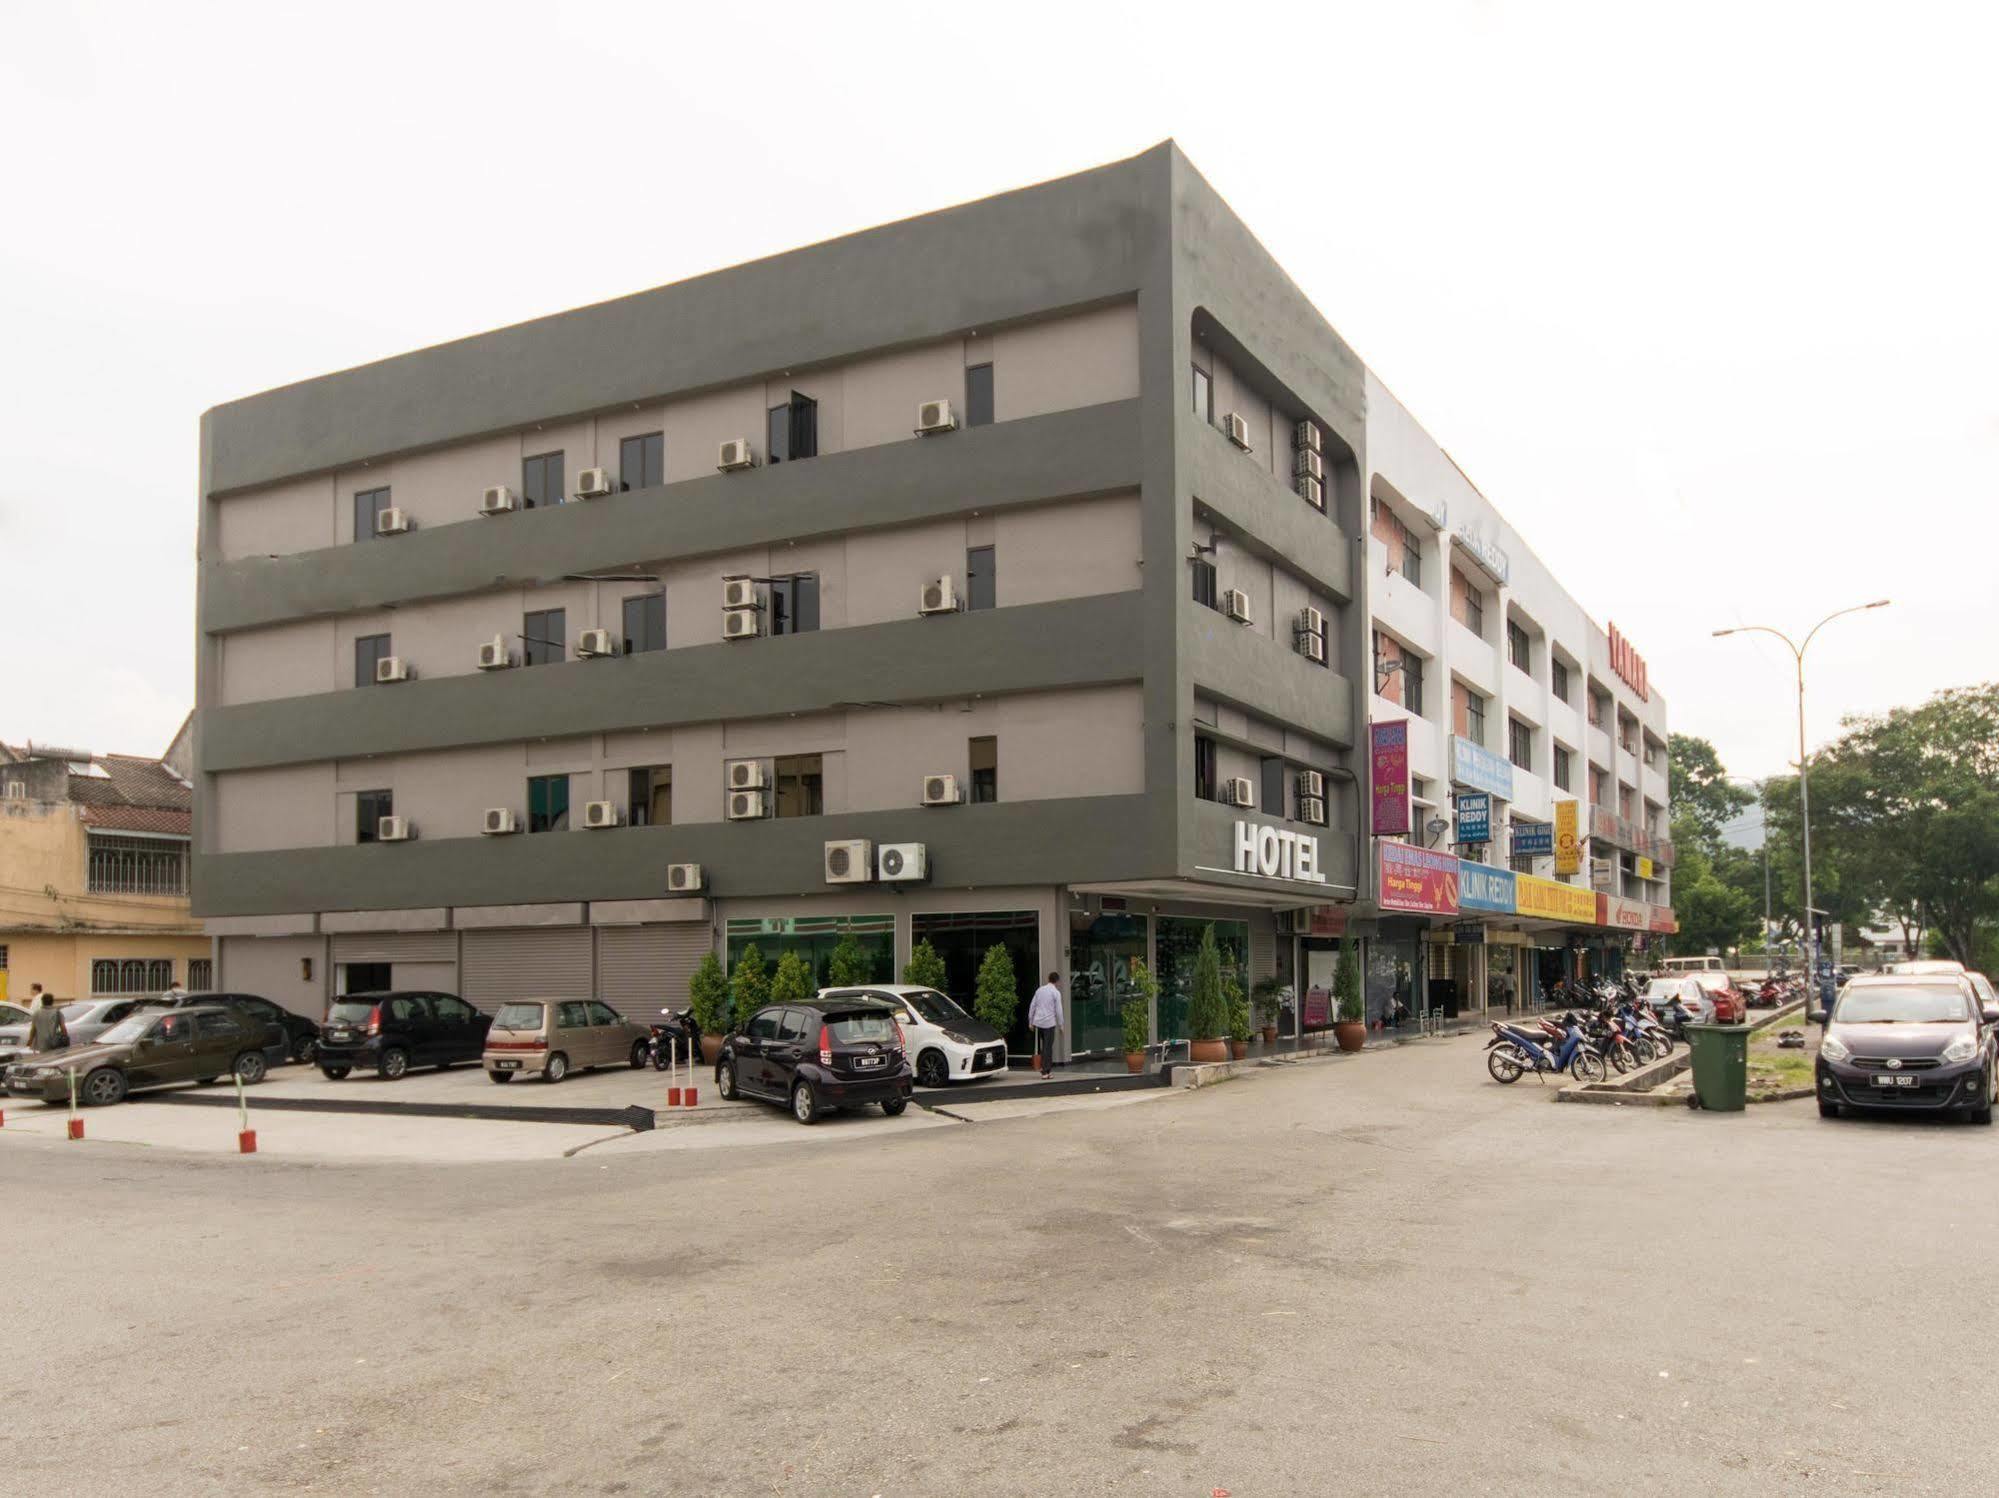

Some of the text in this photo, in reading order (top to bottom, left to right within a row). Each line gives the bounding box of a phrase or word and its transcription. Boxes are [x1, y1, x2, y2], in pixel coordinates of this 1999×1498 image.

[1460, 798, 1487, 811] KLINIK
[1460, 810, 1487, 823] REDDY
[1514, 825, 1536, 838] KLINIK
[1234, 821, 1326, 883] HOTEL
[1387, 875, 1405, 891] Harga
[1405, 879, 1423, 894] Tinggi
[1460, 870, 1487, 900] KLINIK
[1488, 876, 1513, 904] REDDY
[1896, 1076, 1913, 1086] 1207
